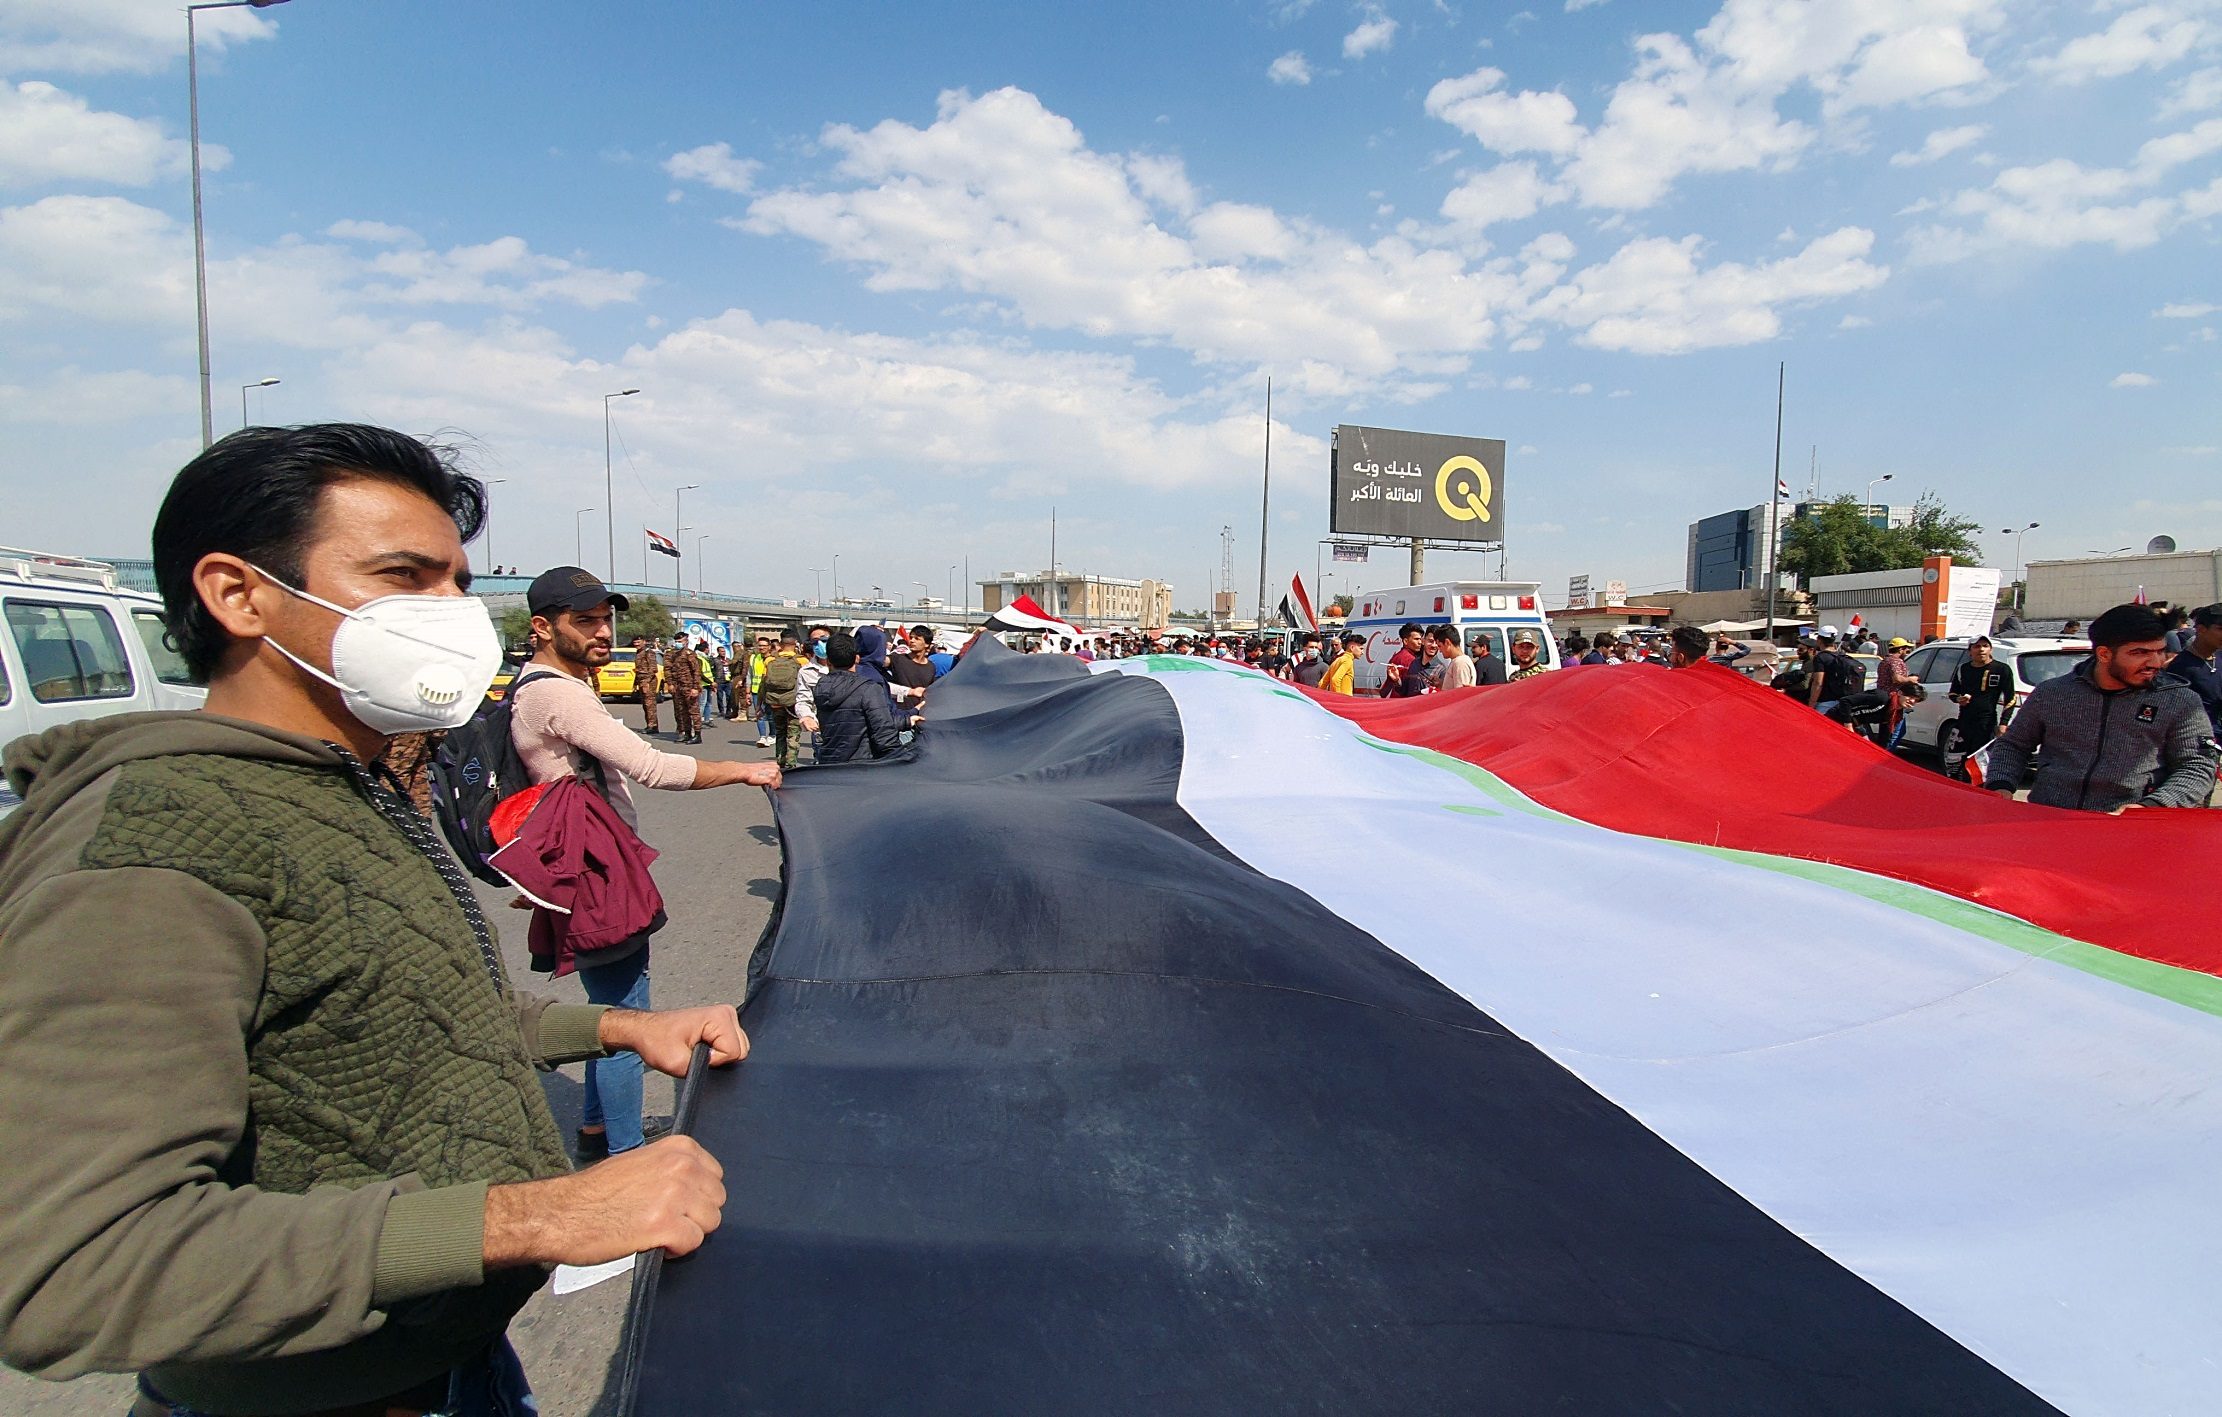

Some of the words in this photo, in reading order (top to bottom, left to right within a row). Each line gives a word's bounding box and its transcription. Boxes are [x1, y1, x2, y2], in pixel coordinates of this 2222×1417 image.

[1384, 460, 1422, 479] خليك
[1350, 481, 1381, 502] الأكبر
[1385, 487, 1422, 503] العائلة
